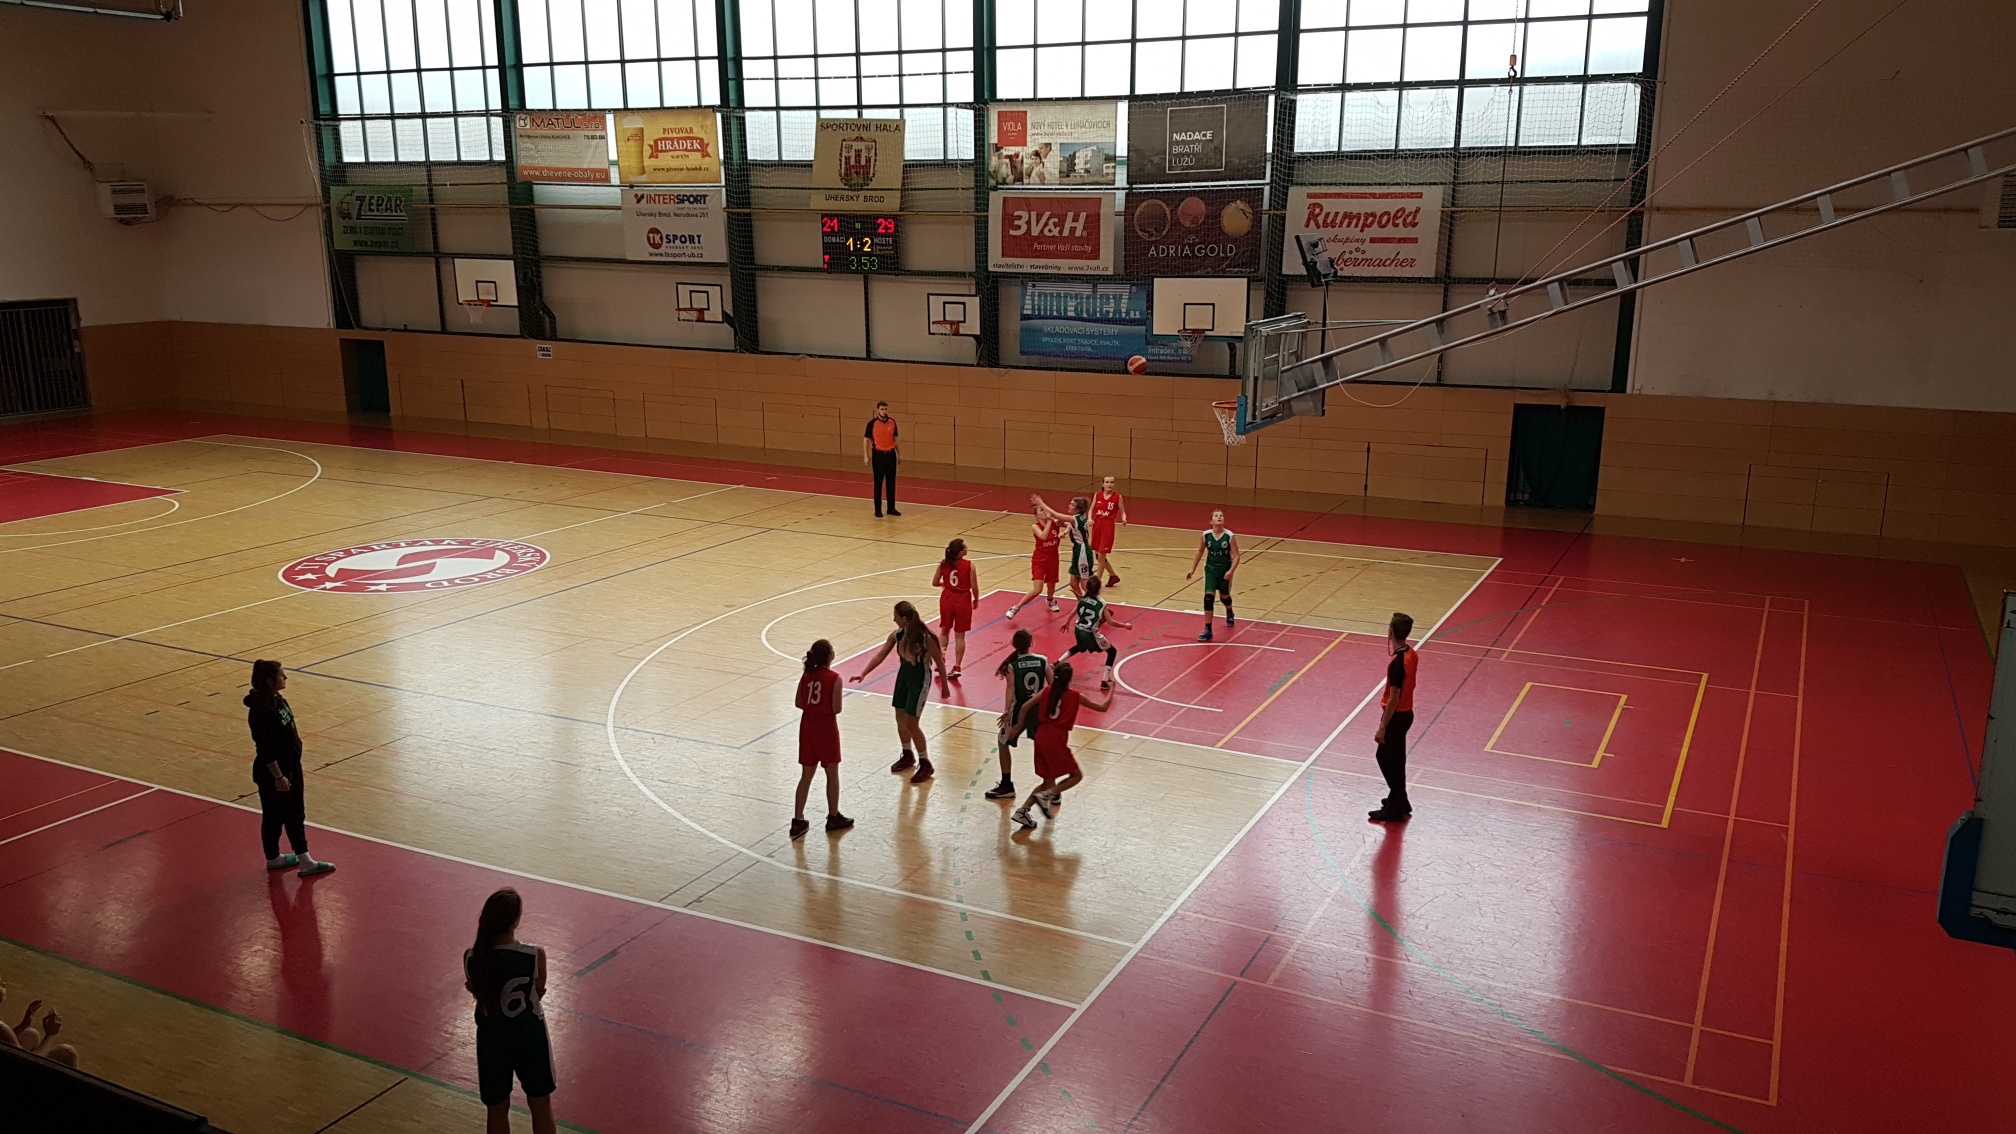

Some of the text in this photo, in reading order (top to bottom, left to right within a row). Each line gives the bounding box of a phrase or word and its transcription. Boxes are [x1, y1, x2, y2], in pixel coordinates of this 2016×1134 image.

[532, 117, 581, 129] MATUL
[820, 122, 901, 132] SPORTOVNÍ HALA
[1002, 121, 1022, 132] VIOLA
[1030, 120, 1046, 130] NOVÝ
[1047, 121, 1064, 130] HOTEL
[662, 126, 695, 135] PIVOVAR
[1172, 130, 1214, 141] NADACE
[657, 139, 702, 151] HRÁDEK
[1172, 142, 1203, 154] BRATŘÍ
[1172, 155, 1195, 166] LUŽŮ
[645, 193, 709, 205] INTERSPORT
[824, 193, 885, 203] UHERSKÝ BROD
[354, 194, 406, 221] ZEPAR
[1008, 210, 1087, 237] 3V&H
[1304, 202, 1421, 233] Rumpold
[822, 216, 895, 234] 21 29
[648, 233, 702, 245] TK SPORT
[1326, 233, 1367, 246] skupiny
[1033, 242, 1056, 250] Partner
[1070, 244, 1092, 253] stavby
[1107, 502, 1115, 511] 15
[1051, 529, 1058, 538] 9
[314, 538, 462, 562] SPARTAK
[424, 564, 514, 588] BROD
[949, 569, 959, 587] 6
[1076, 605, 1097, 629] 13
[1023, 671, 1040, 697] 9
[807, 680, 822, 705] 13
[500, 976, 530, 1018] 6
